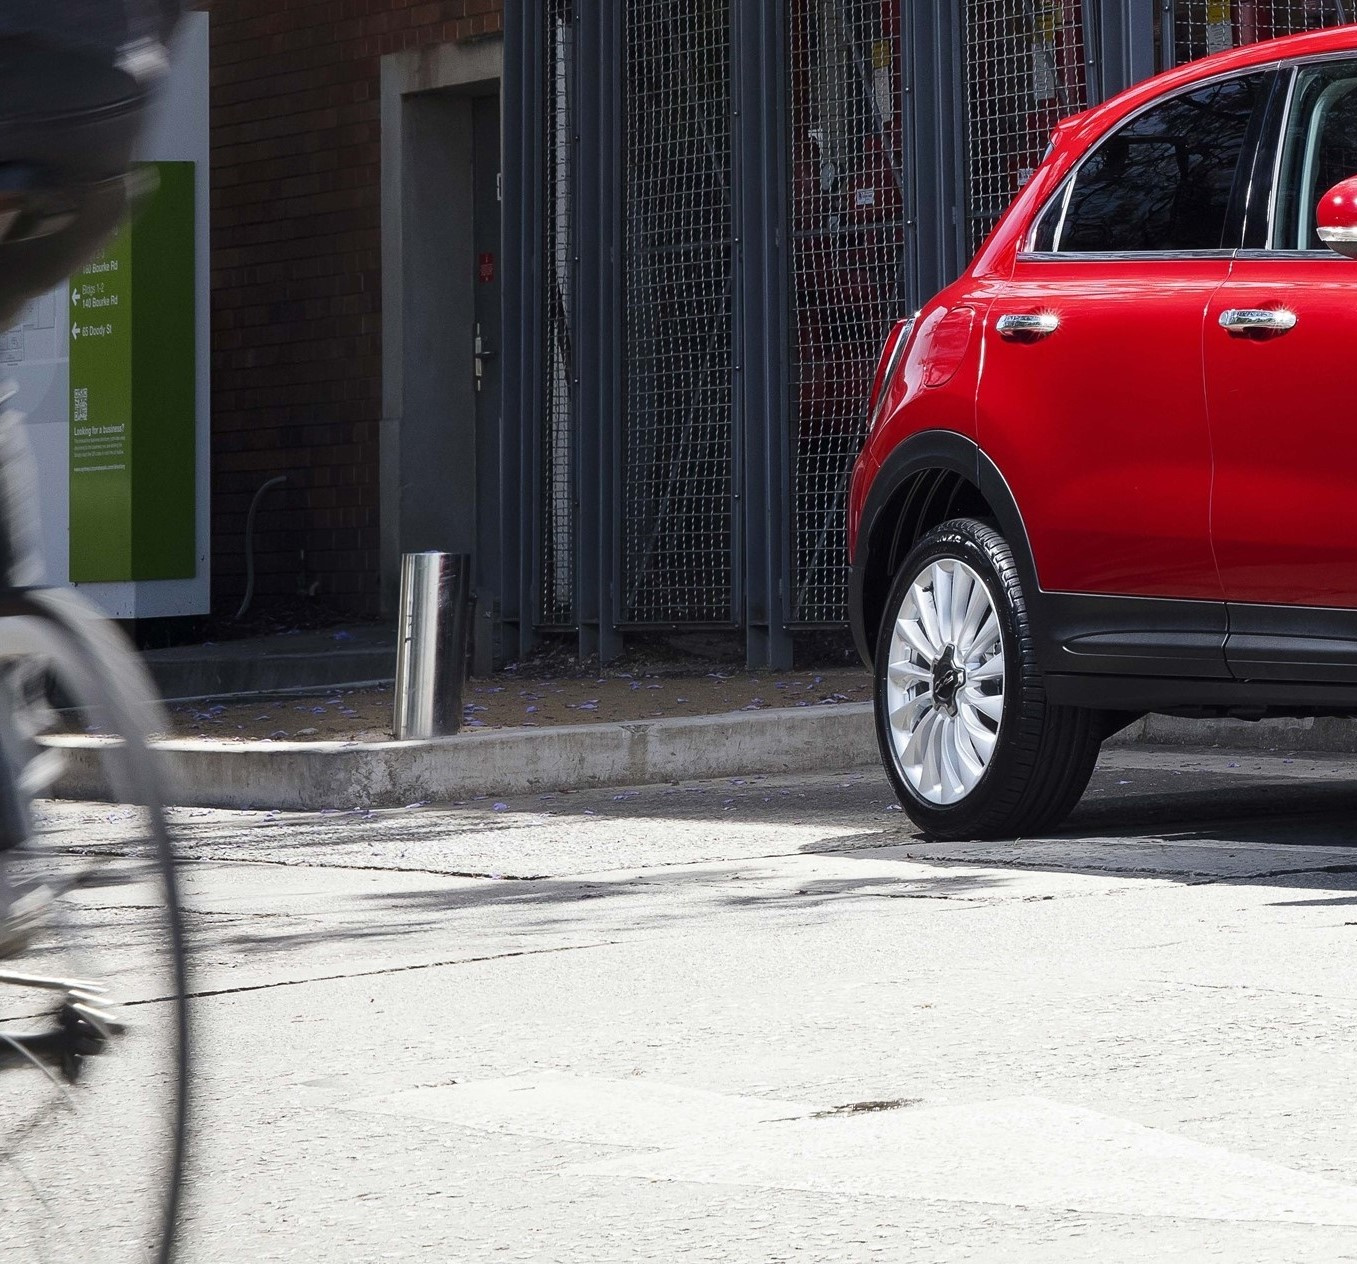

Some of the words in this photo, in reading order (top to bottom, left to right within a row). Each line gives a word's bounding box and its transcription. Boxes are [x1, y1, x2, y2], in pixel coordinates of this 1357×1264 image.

[92, 261, 110, 273] Bourke
[110, 260, 118, 271] Rd
[92, 296, 110, 308] Bourke
[110, 295, 118, 305] Rd
[89, 325, 106, 337] Doody
[106, 323, 112, 334] St
[74, 426, 91, 437] Looking
[103, 423, 125, 434] business?
